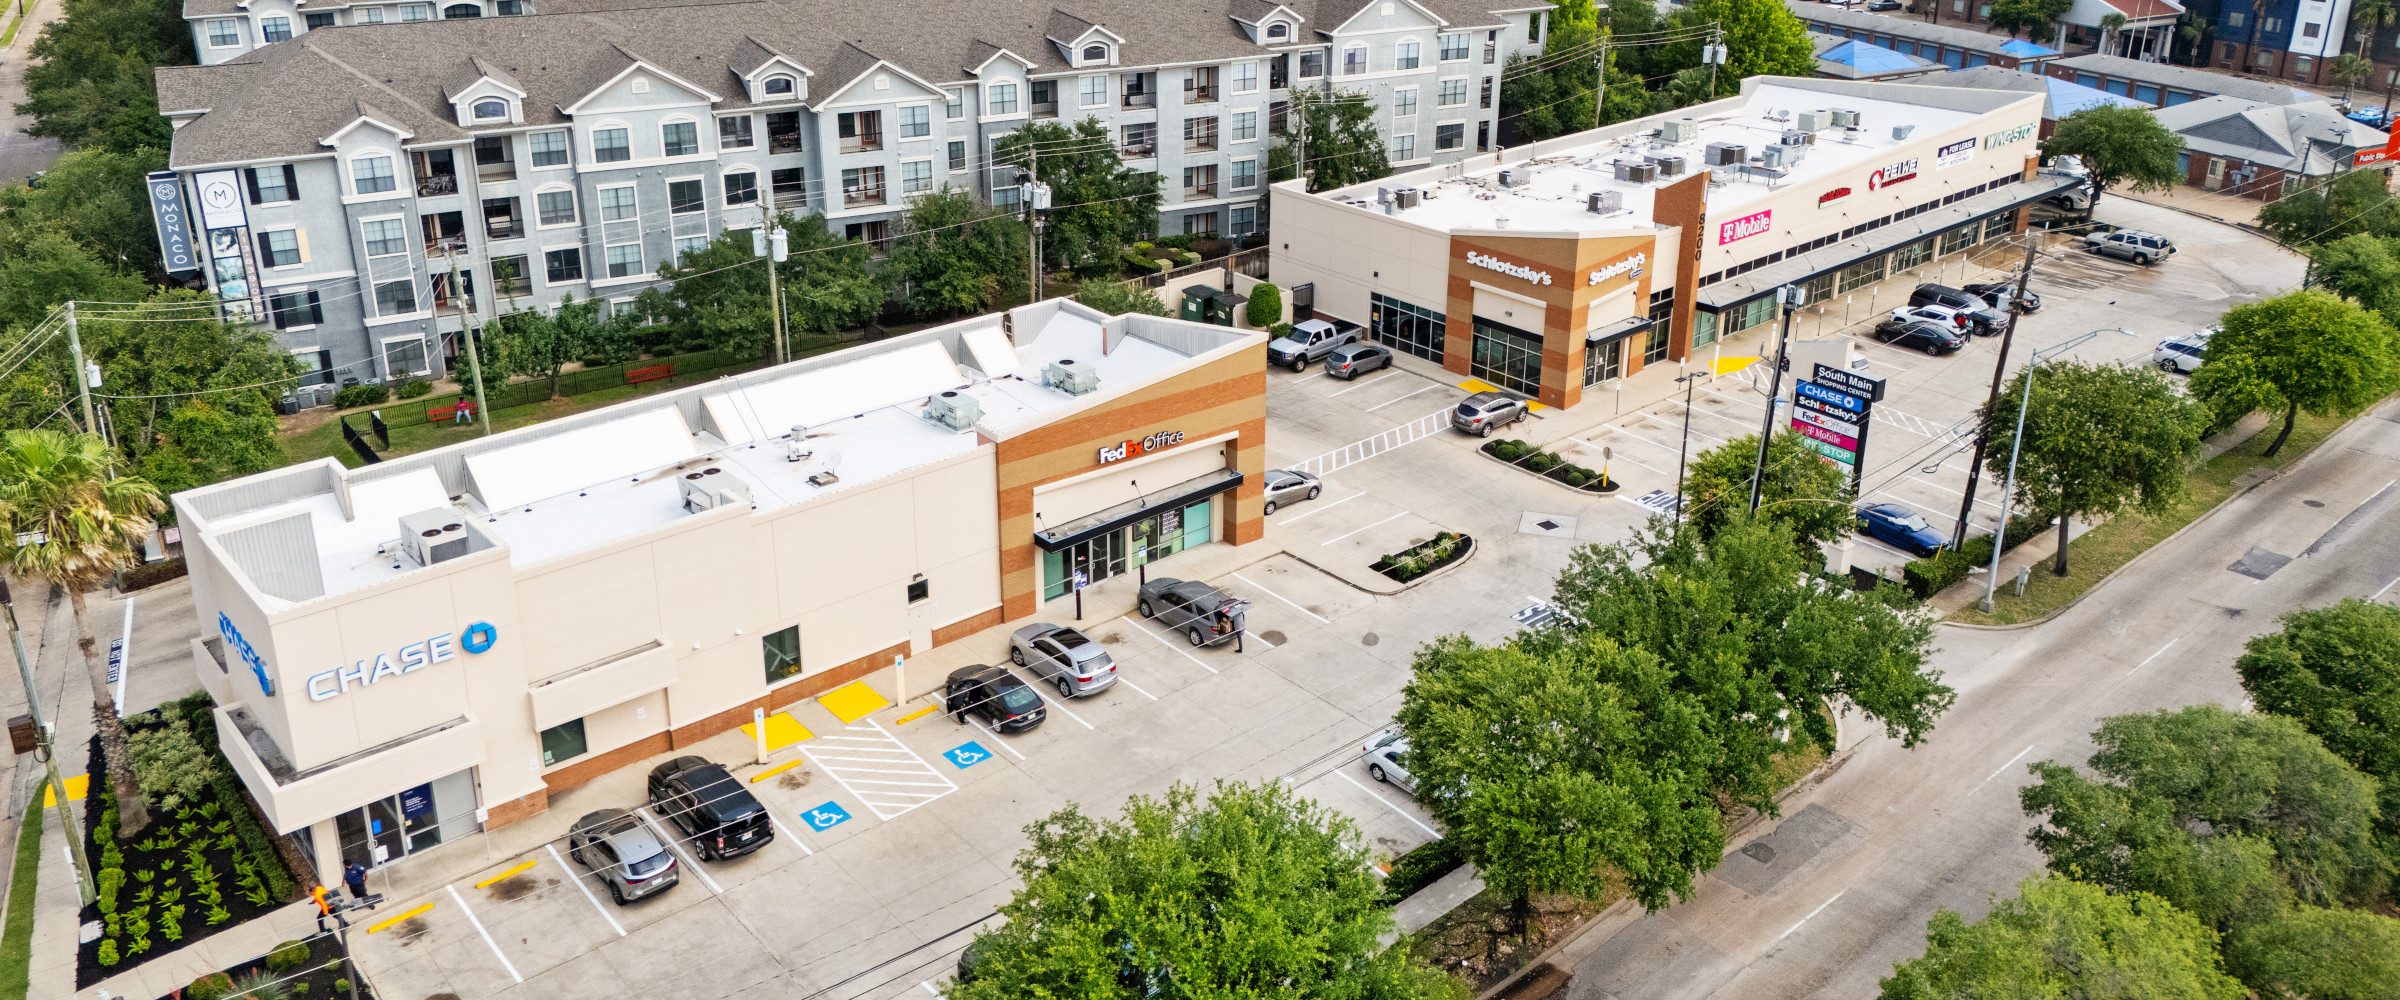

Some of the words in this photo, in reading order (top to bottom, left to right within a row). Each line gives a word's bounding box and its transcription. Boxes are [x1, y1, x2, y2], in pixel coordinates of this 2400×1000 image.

[1959, 140, 1974, 151] LEASE
[213, 189, 227, 201] M
[205, 208, 242, 216] MONACO
[161, 203, 188, 264] MONACO
[1694, 213, 1706, 262] 8200
[1733, 213, 1770, 240] Mobile
[1467, 251, 1552, 286] Schlotzsky's
[1588, 252, 1646, 286] Schlotzsky's
[1816, 378, 1847, 392] SHOPPING
[1847, 387, 1872, 400] CENTER
[1818, 366, 1847, 383] South
[1849, 376, 1872, 391] Main
[1805, 385, 1843, 405] CHASE
[1799, 396, 1858, 421] Schlotzsky's
[1815, 429, 1841, 444] Mobile
[307, 633, 457, 702] CHASE
